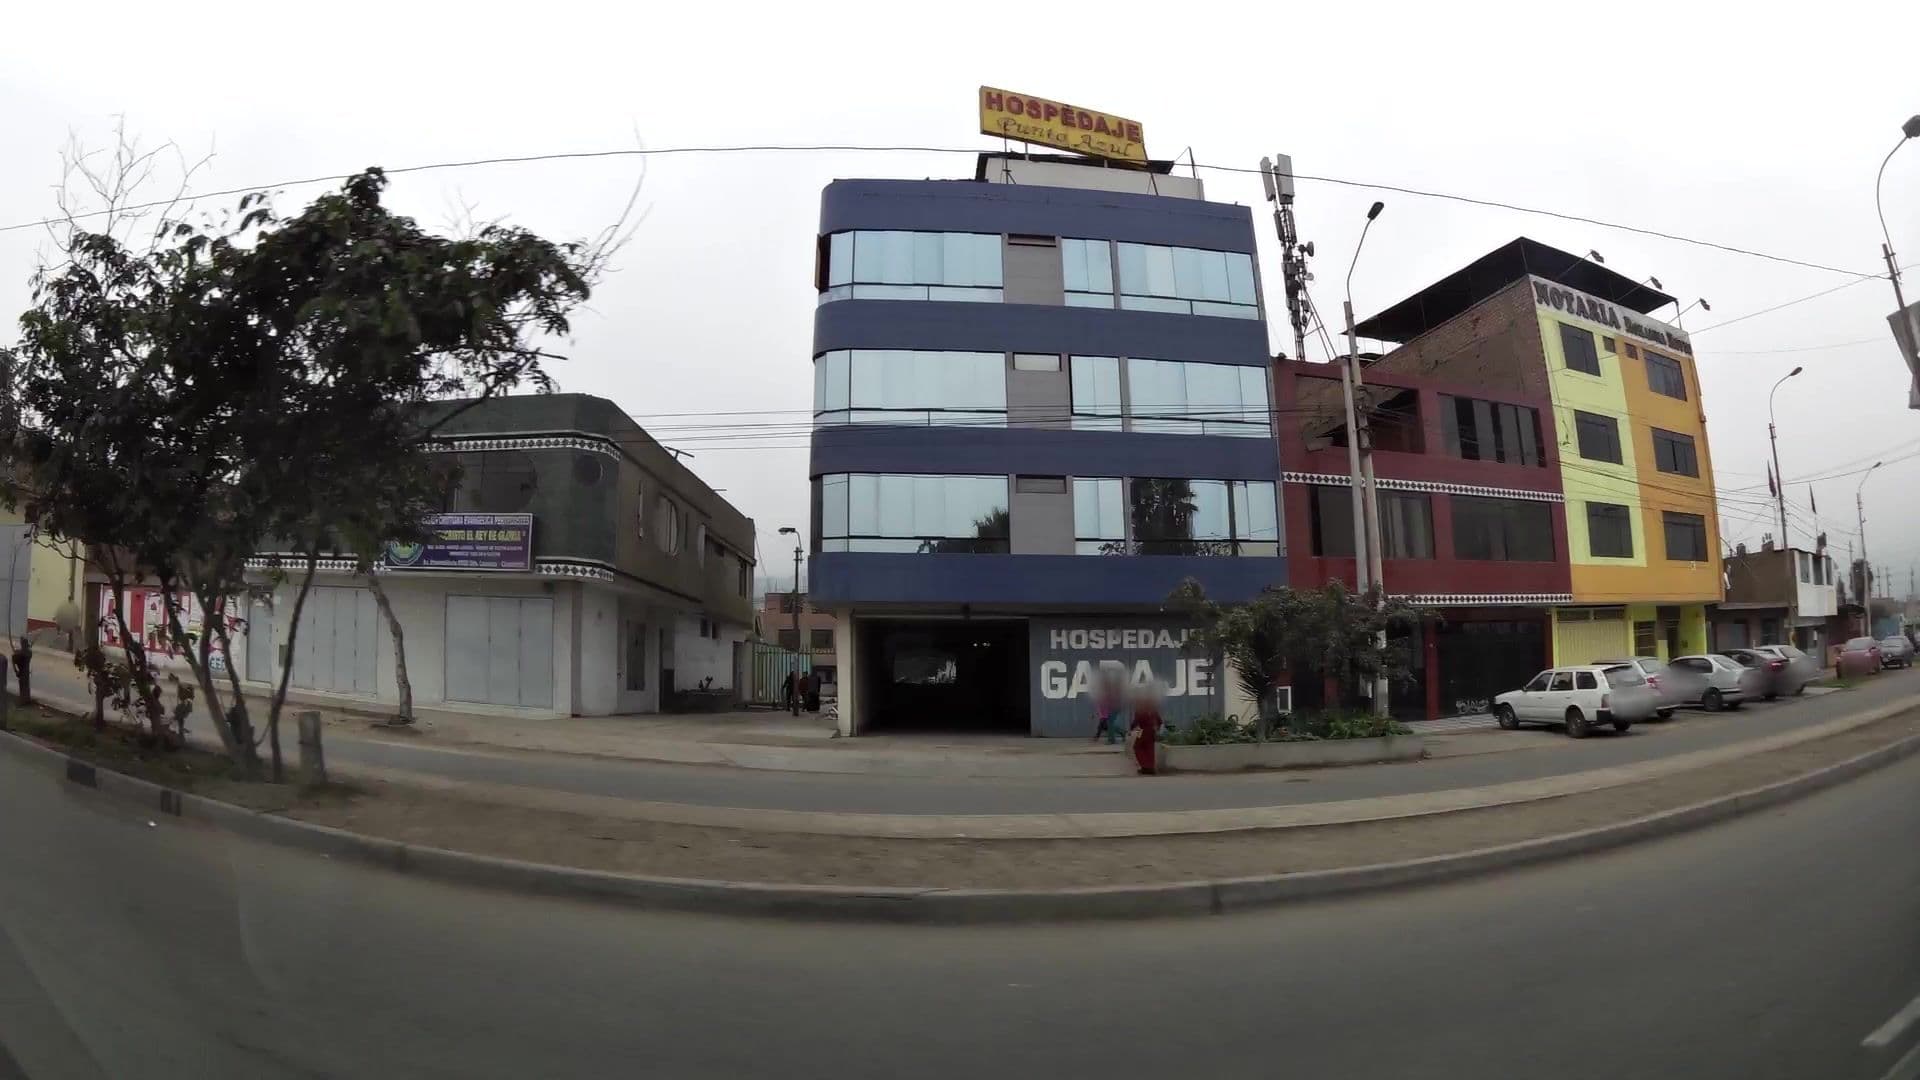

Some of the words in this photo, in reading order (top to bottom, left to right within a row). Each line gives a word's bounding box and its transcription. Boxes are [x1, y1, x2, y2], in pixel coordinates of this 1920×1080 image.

[985, 91, 1142, 144] HOSPEDAJE
[1533, 281, 1622, 330] NOTARIA
[1040, 659, 1216, 699] GAAJE
